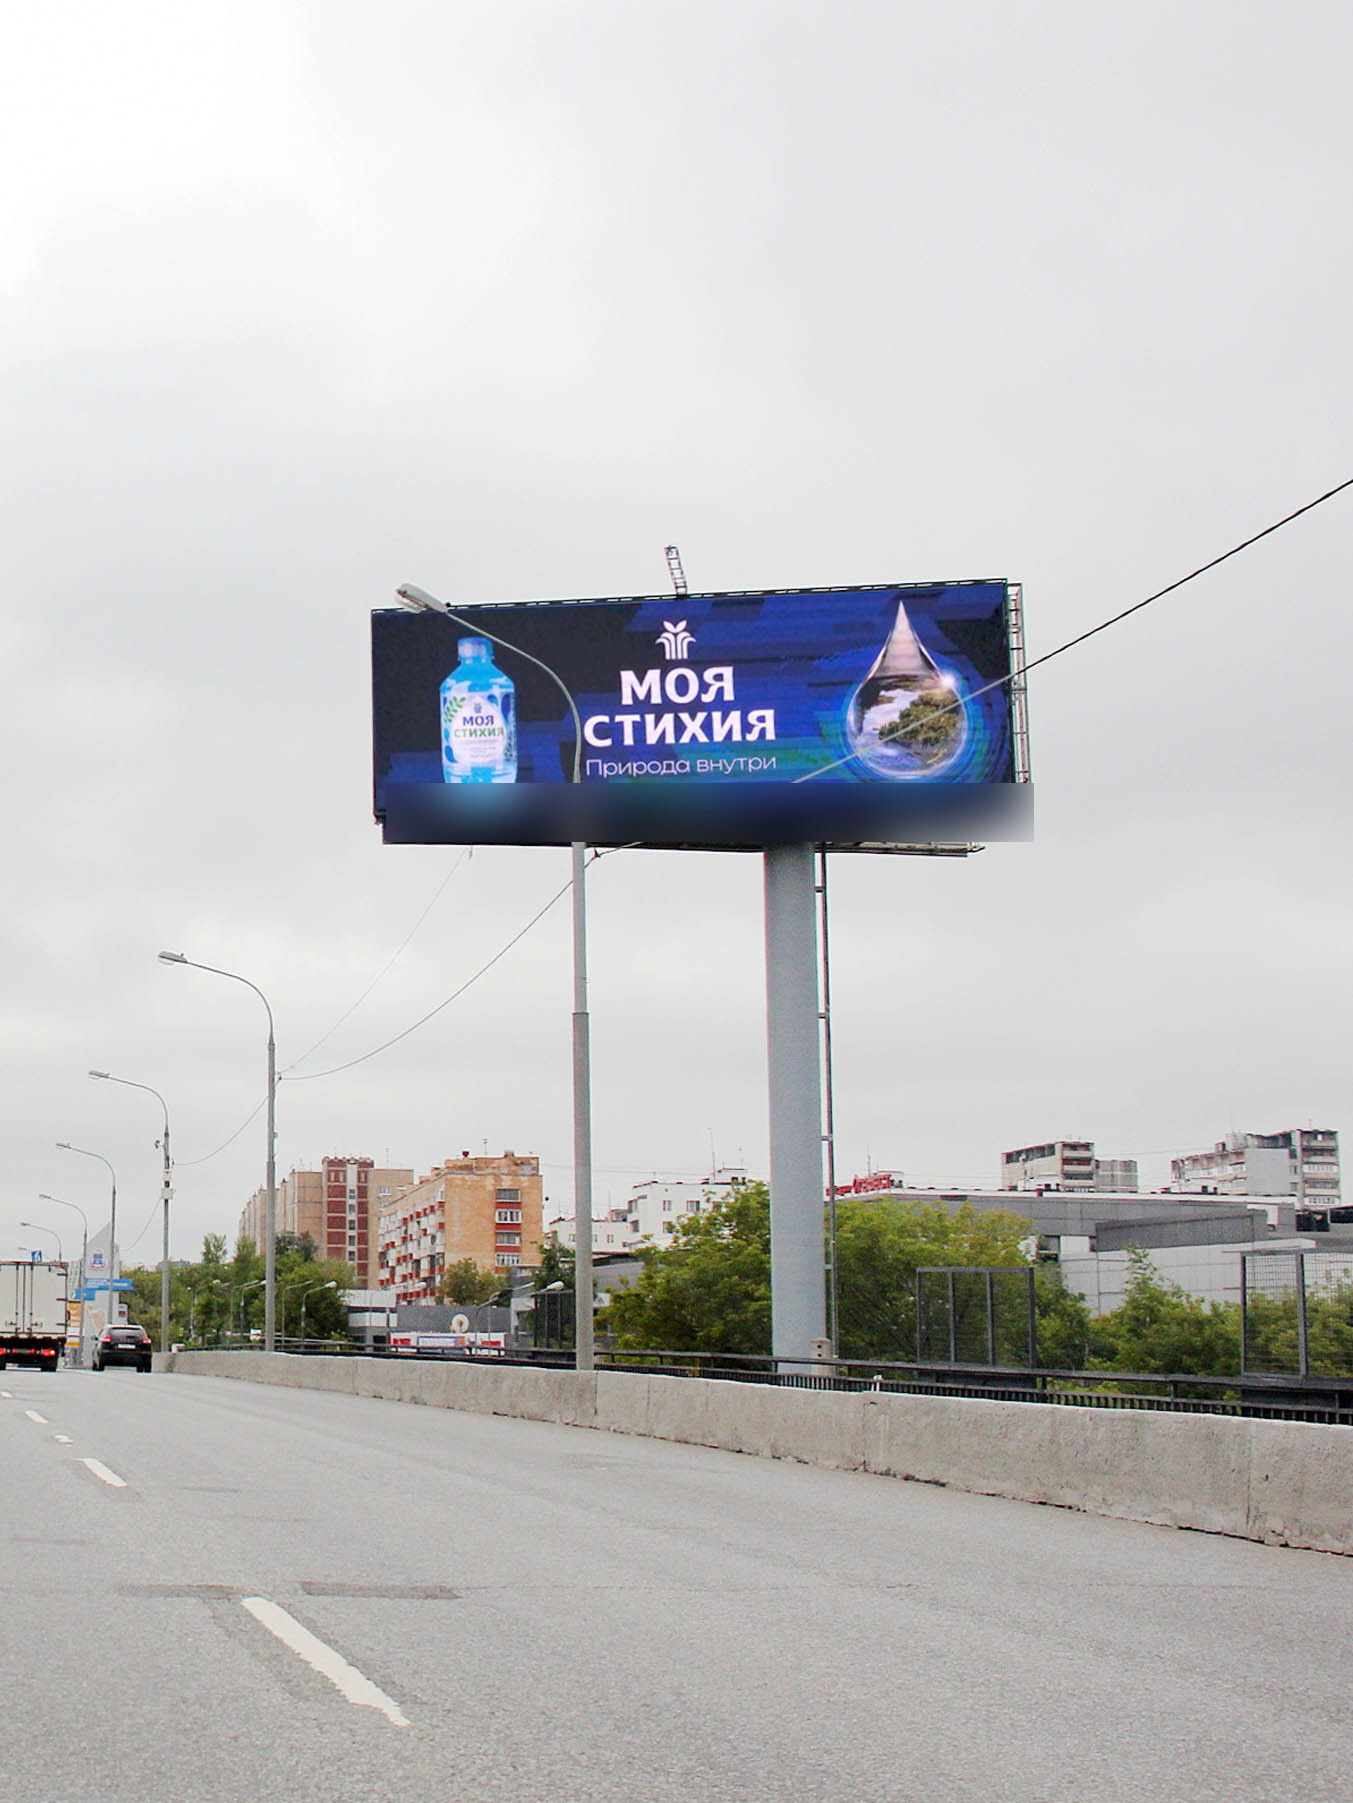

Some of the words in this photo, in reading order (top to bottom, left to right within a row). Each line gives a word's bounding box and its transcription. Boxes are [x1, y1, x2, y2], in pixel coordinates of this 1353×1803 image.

[620, 666, 735, 705] МОЯ
[462, 714, 495, 726] МОЯ
[583, 709, 776, 747] СТИХИЯ
[454, 727, 505, 738] СТИХИЯ
[586, 759, 690, 778] Природа
[696, 756, 777, 775] внутри
